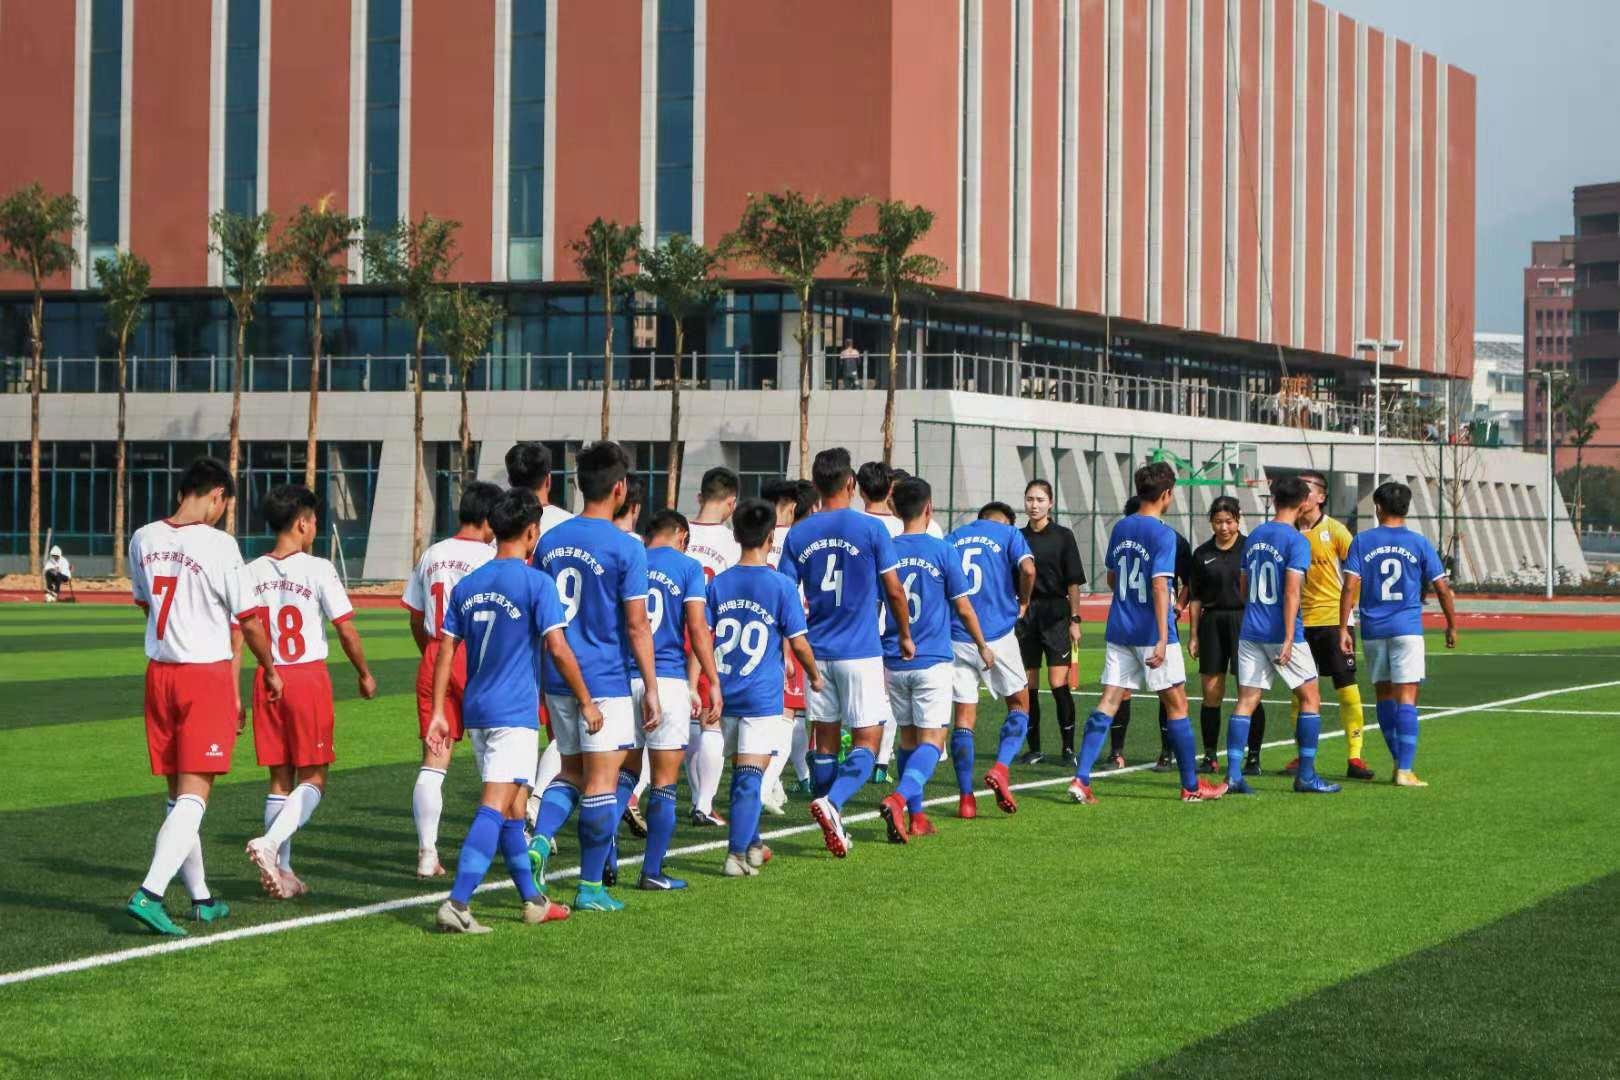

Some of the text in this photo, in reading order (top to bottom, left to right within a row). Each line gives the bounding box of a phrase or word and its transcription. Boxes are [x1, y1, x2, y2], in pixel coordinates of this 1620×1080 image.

[556, 567, 582, 624] 9
[821, 554, 843, 607] 4
[961, 547, 983, 595] 5
[1118, 555, 1148, 604] 14
[1249, 559, 1278, 605] 10
[1380, 558, 1404, 601] 2
[152, 576, 178, 640] 7
[645, 588, 664, 634] 9
[902, 572, 921, 624] 6
[473, 610, 496, 672] 7
[714, 617, 769, 676] 29
